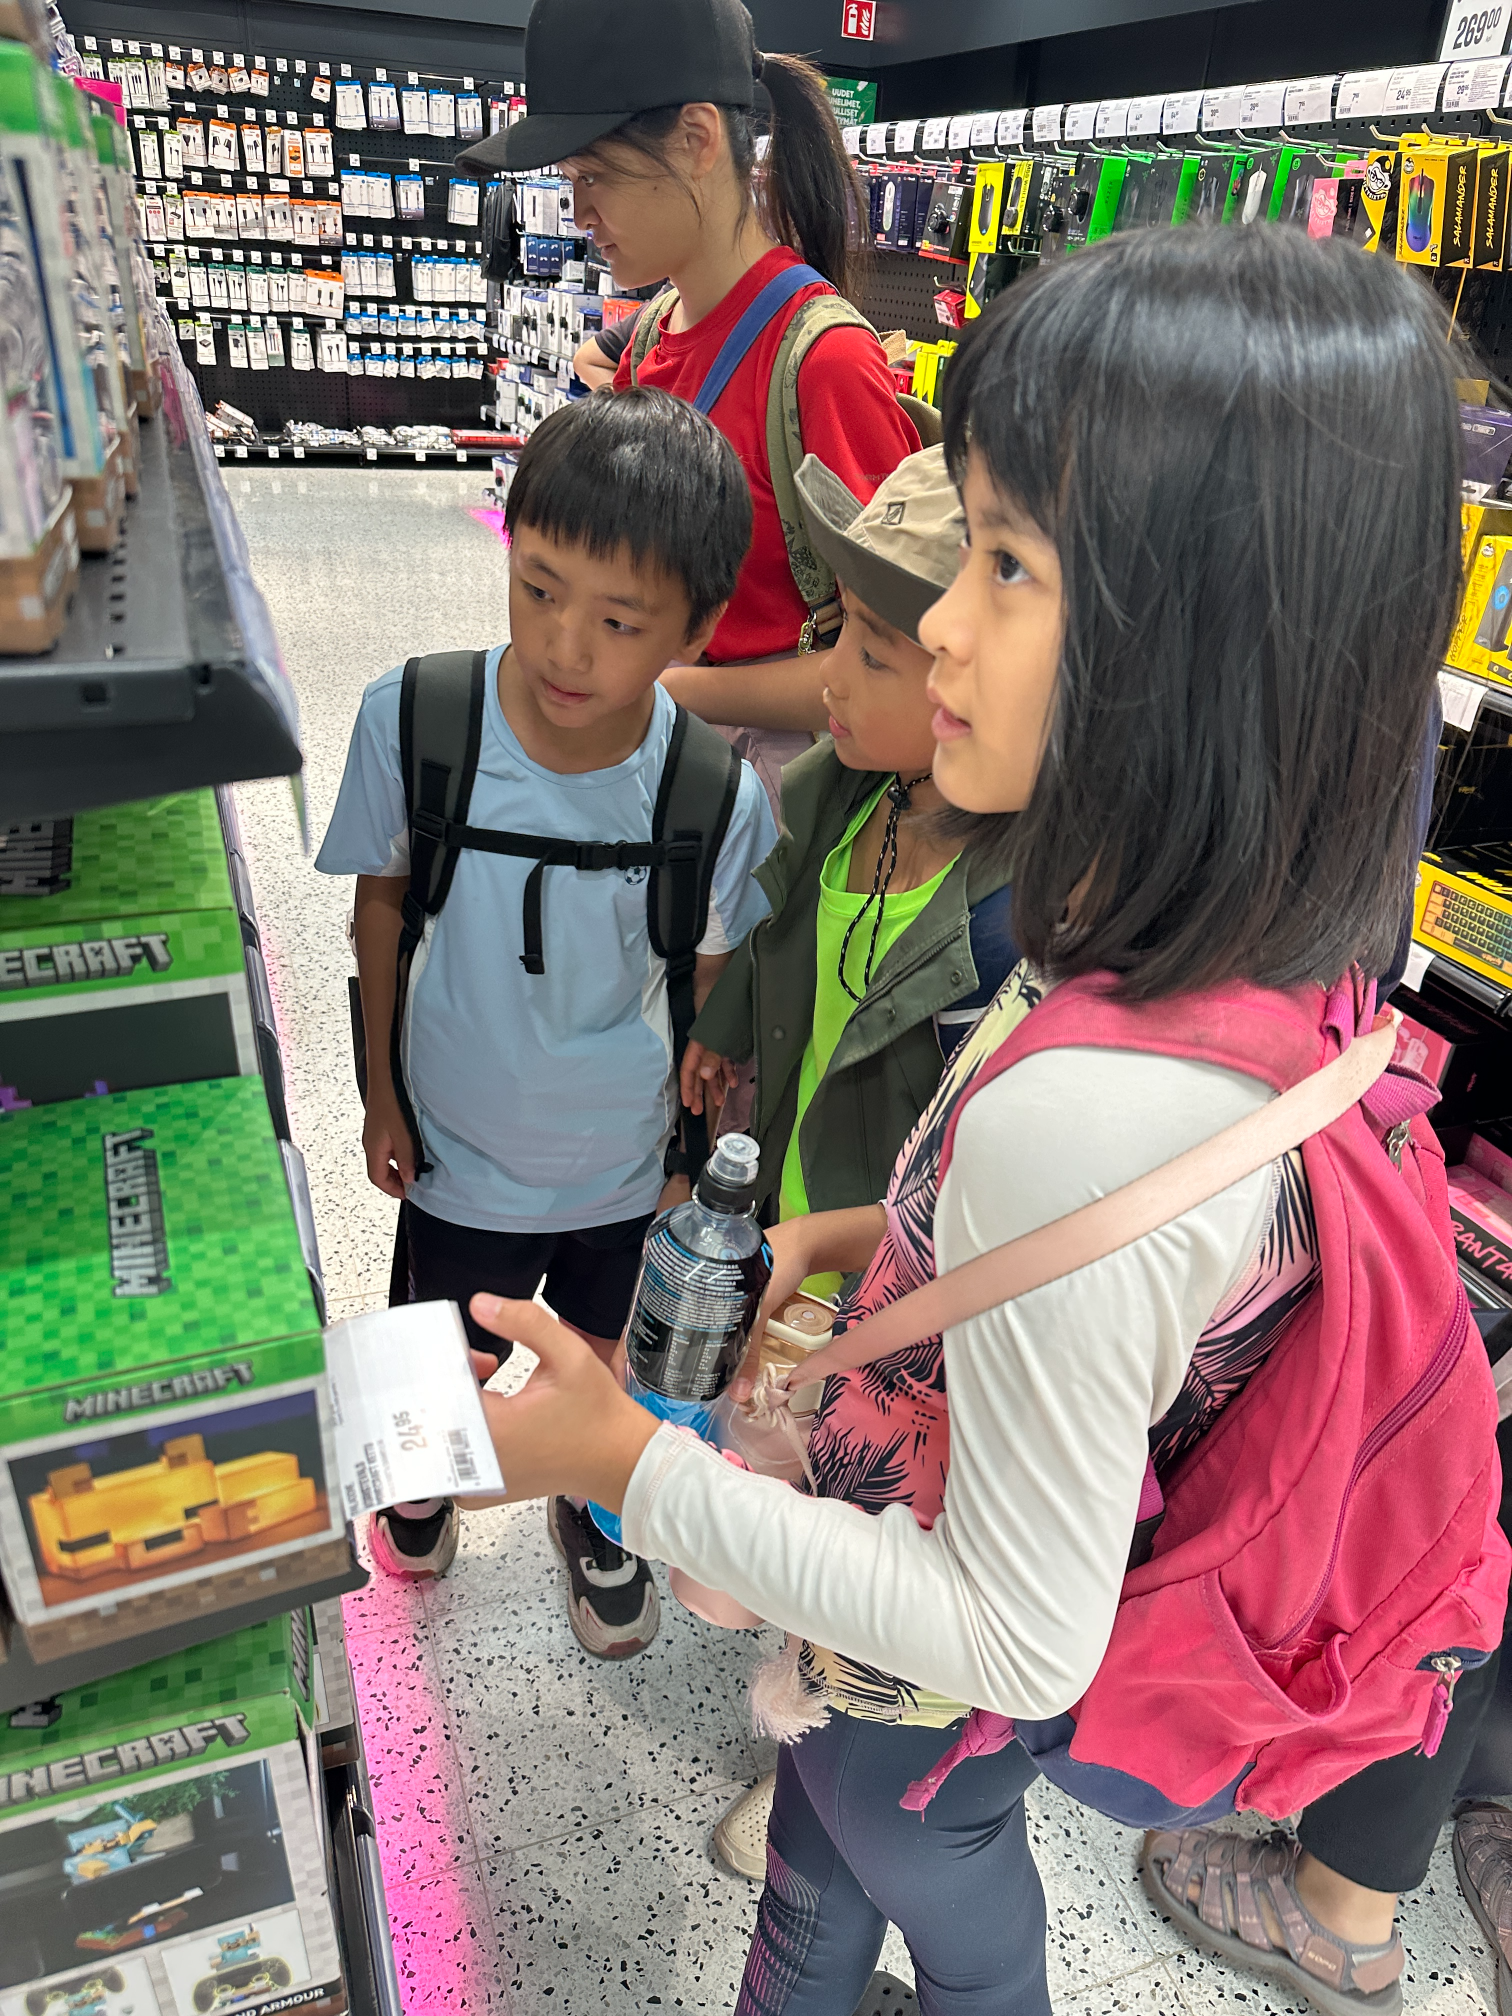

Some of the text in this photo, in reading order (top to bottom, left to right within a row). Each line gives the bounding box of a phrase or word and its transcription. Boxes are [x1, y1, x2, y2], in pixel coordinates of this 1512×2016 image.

[828, 96, 861, 109] UHELIMET,
[831, 88, 855, 98] UUDET
[1453, 165, 1467, 248] SALAMANDER
[1485, 168, 1498, 249] SALAMANDER
[102, 1125, 173, 1299] MINECRAFT
[62, 1358, 255, 1425] MINECRAFT
[260, 1987, 325, 2015] ARMOUR
